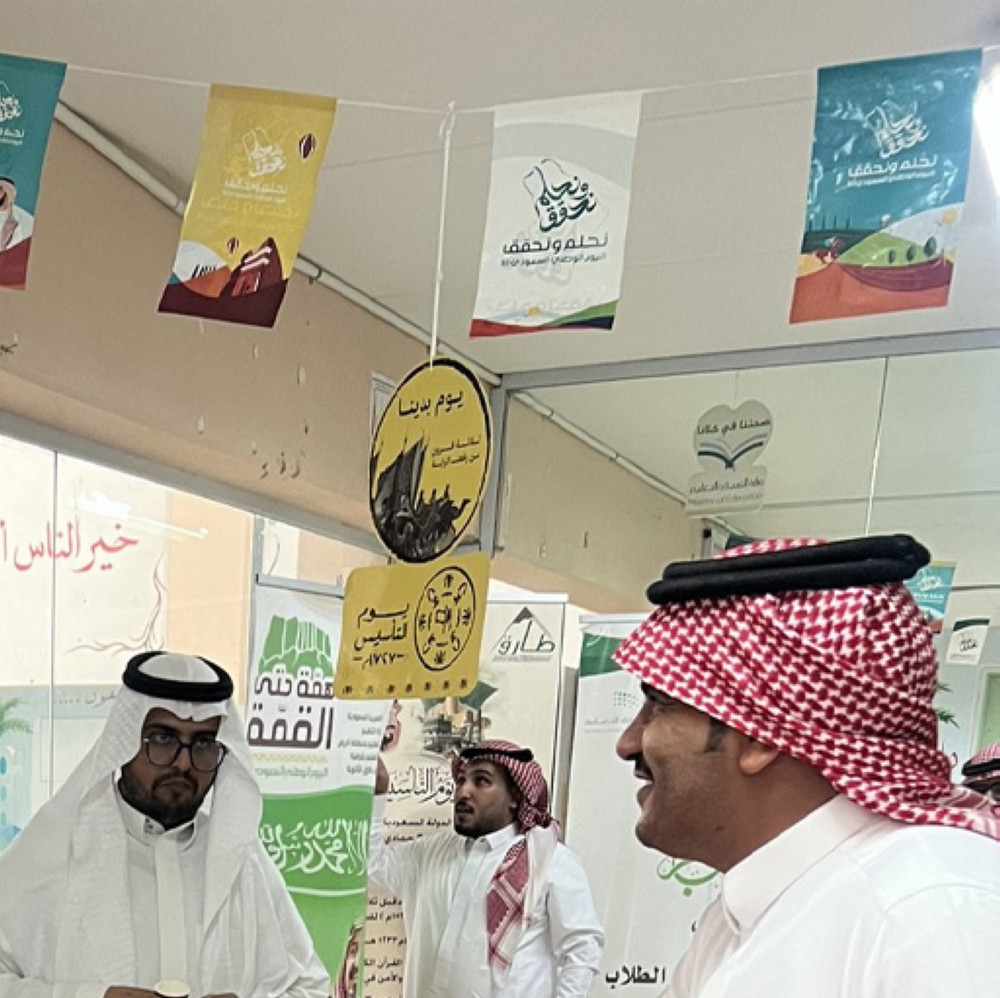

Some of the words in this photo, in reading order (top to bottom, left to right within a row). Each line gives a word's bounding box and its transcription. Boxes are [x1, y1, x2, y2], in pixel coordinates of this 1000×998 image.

[501, 236, 563, 255] ونحقق
[563, 231, 609, 251] نحلم
[433, 390, 464, 417] يوم
[13, 516, 81, 572] الناس
[71, 522, 139, 573] خير
[357, 602, 410, 629] يوم
[498, 619, 556, 656] طارق
[605, 964, 666, 990] الطلاب
